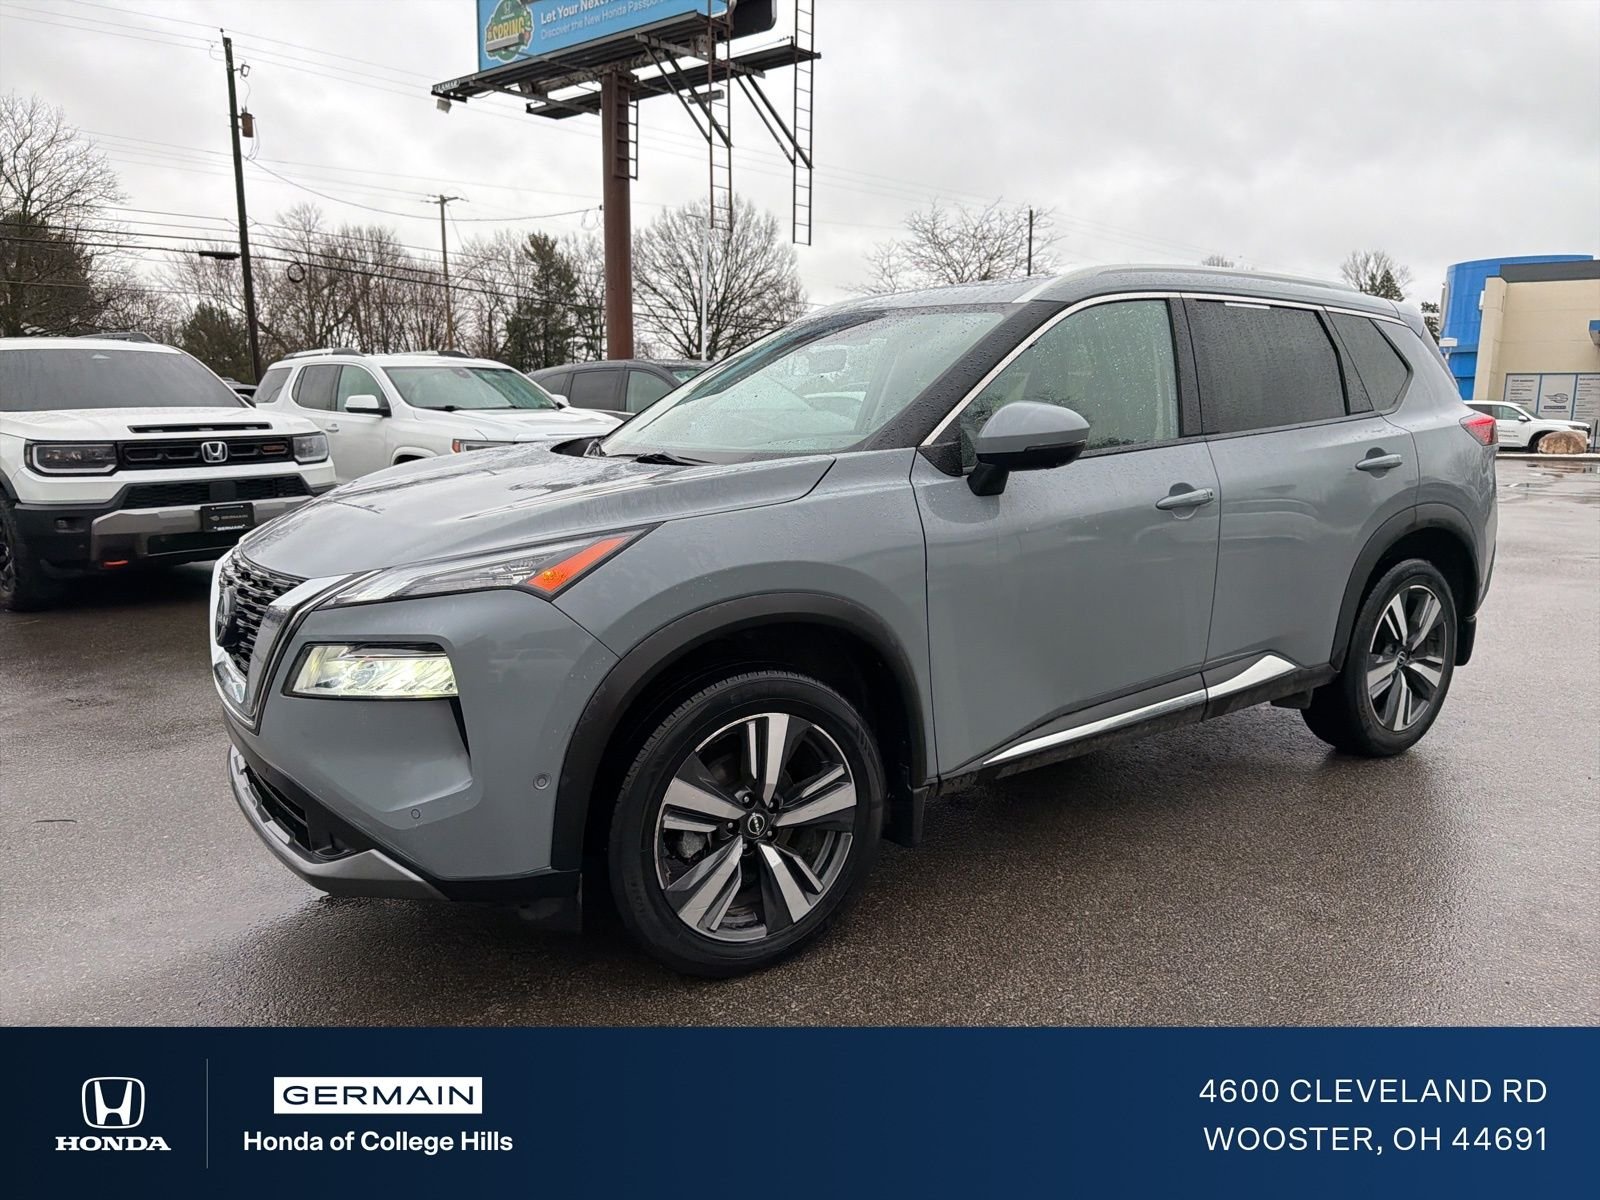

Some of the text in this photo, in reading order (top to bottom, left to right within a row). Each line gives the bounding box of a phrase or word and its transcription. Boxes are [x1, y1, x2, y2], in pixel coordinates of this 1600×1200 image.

[541, 10, 557, 25] Let
[557, 4, 579, 19] Your
[541, 0, 664, 40] Discover the New Honda Passpo
